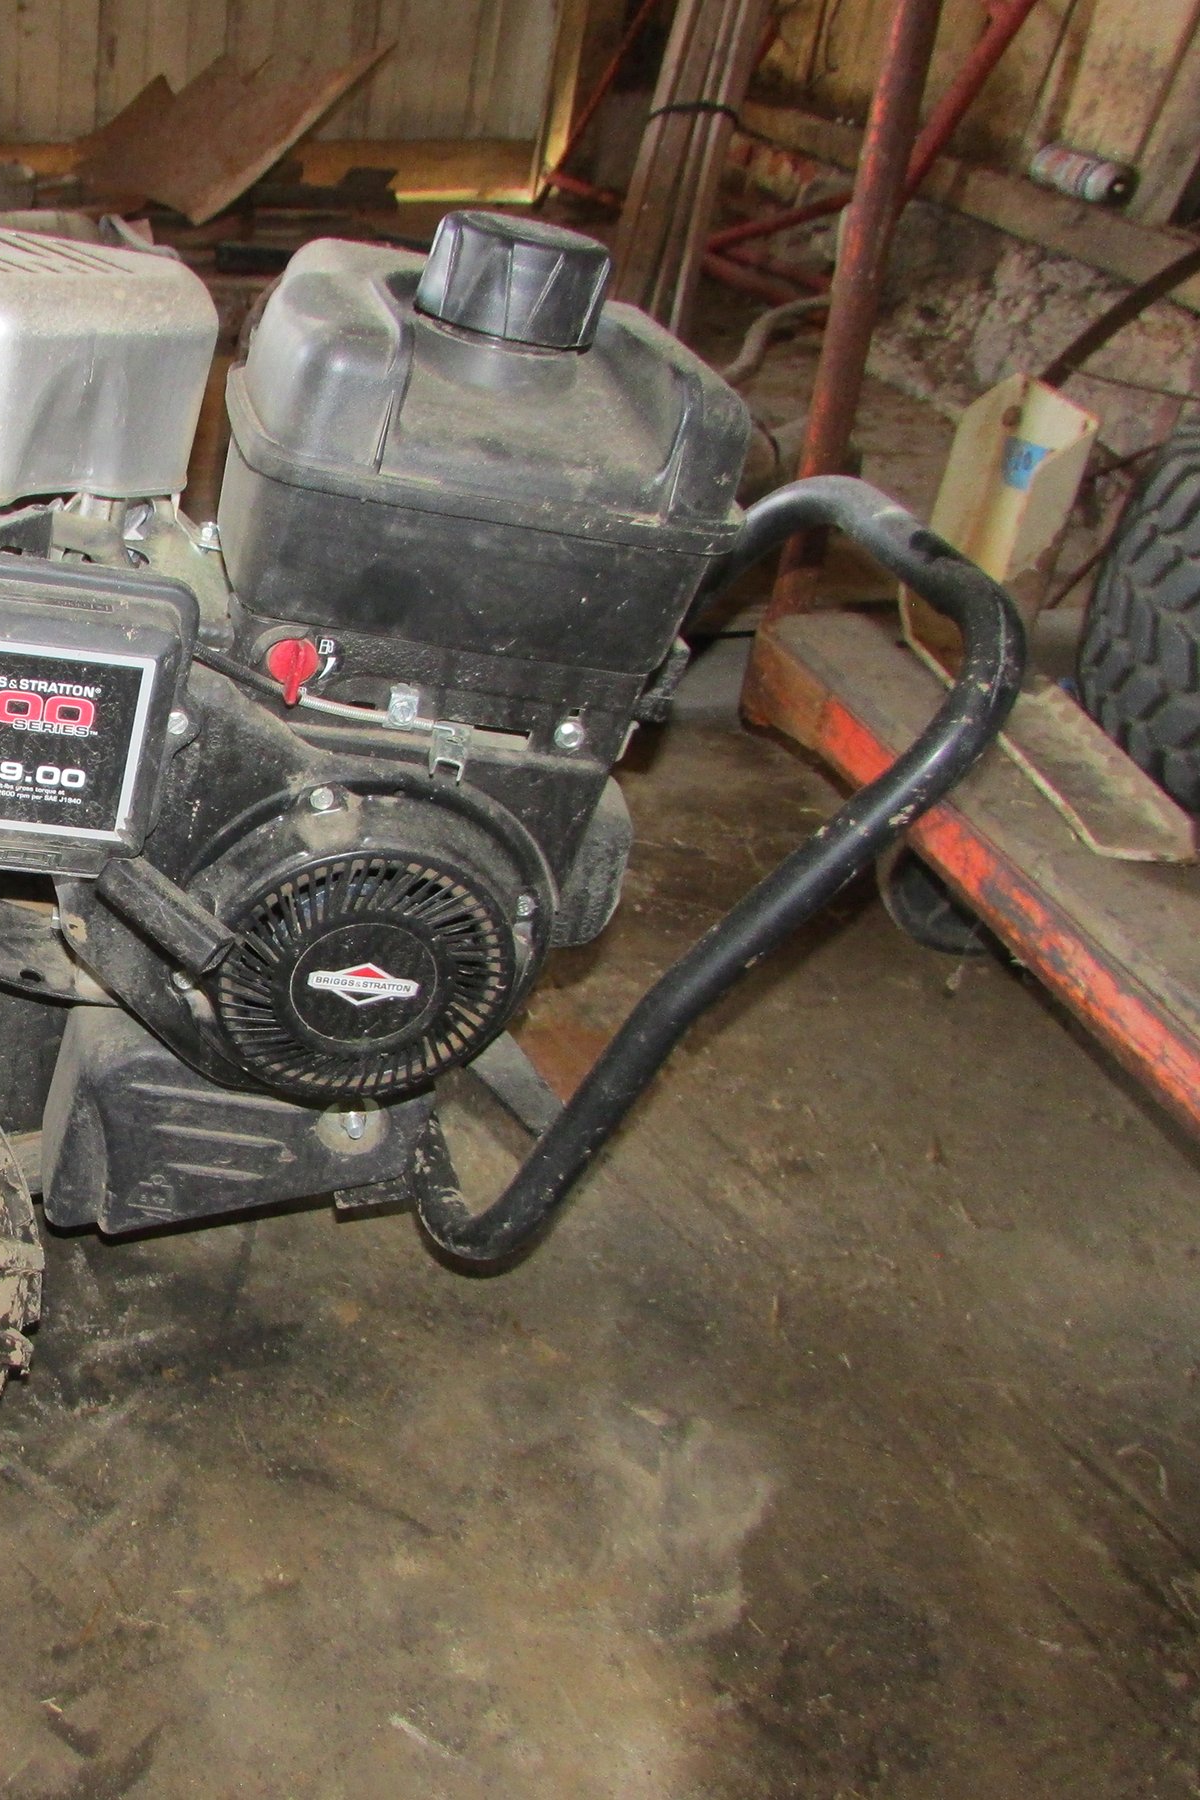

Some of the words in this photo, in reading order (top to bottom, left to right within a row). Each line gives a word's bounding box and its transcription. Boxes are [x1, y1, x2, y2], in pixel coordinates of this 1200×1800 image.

[0, 761, 86, 788] 9.00
[35, 786, 57, 795] torque
[31, 793, 43, 801] per
